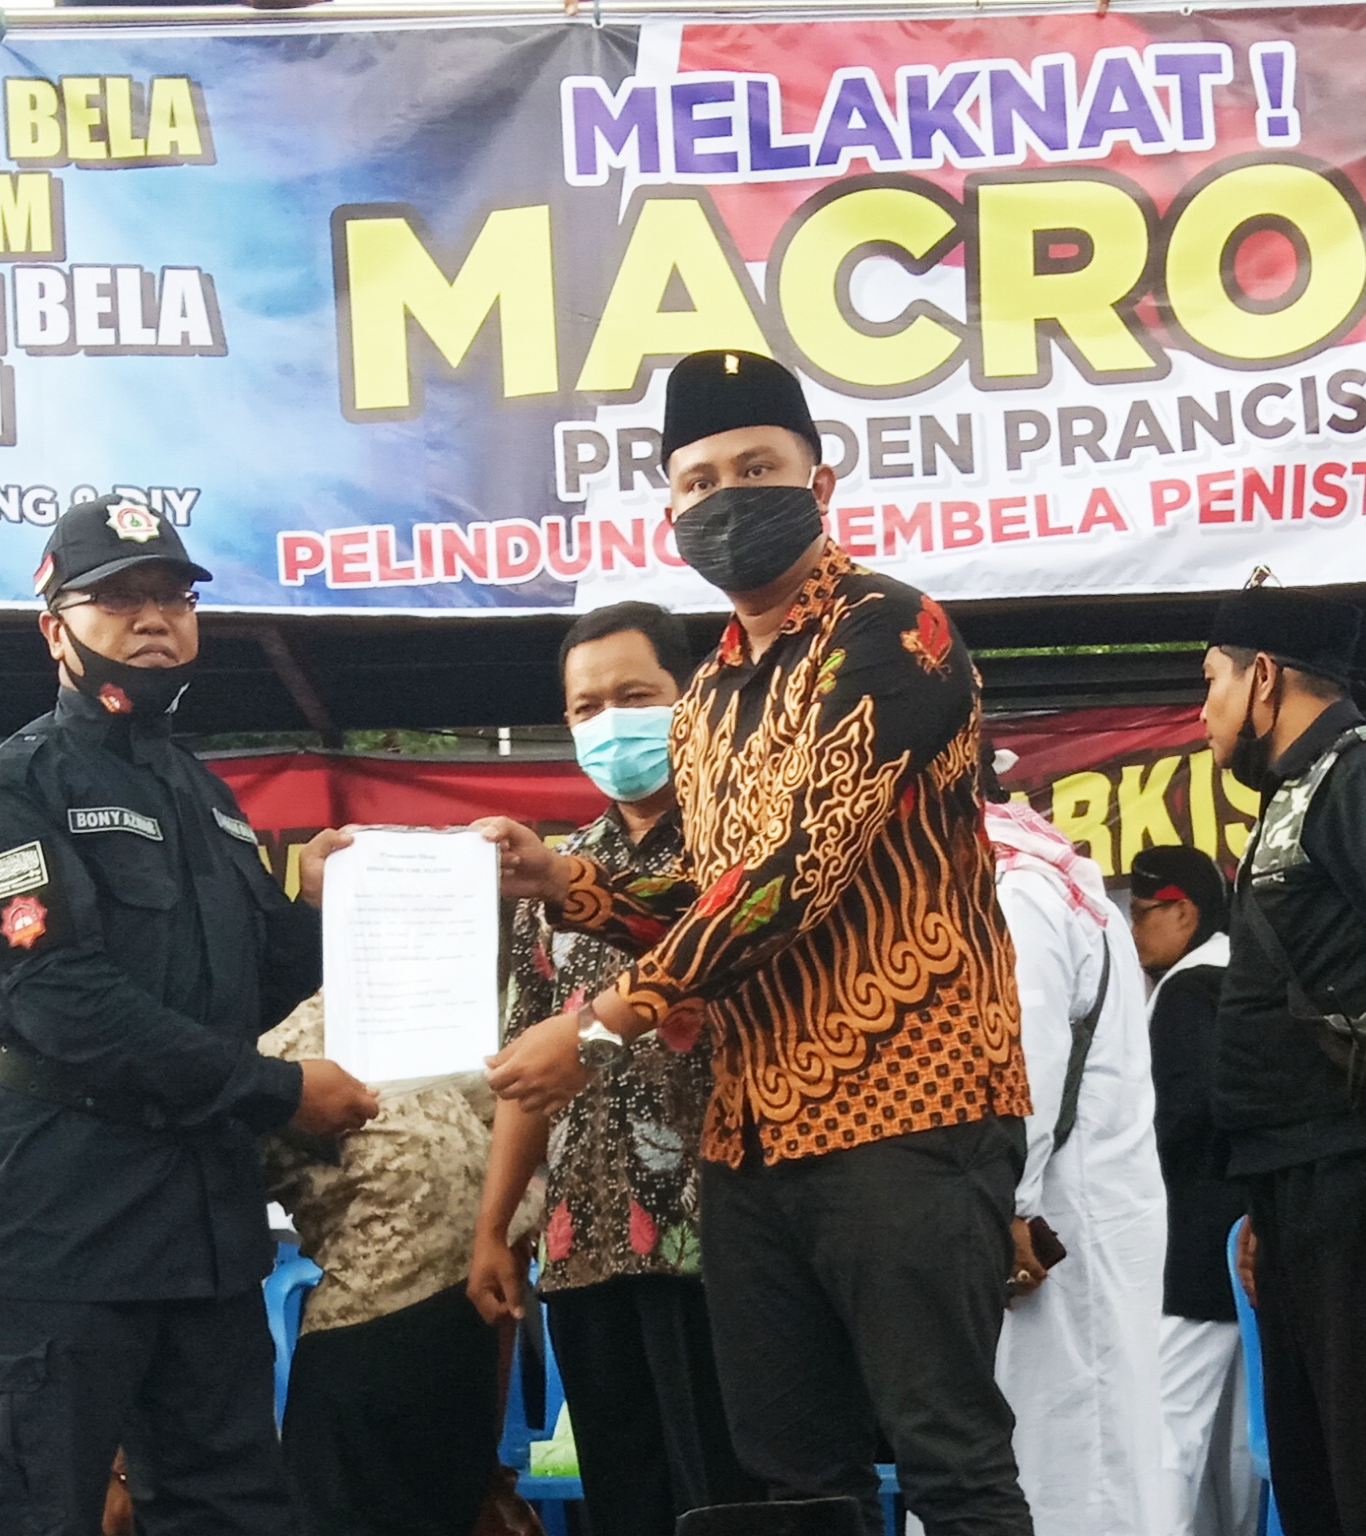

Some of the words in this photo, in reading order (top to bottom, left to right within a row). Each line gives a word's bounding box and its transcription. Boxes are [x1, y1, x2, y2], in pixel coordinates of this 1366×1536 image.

[4, 76, 203, 160] BELA
[571, 53, 1225, 175] MELAKNAT
[1261, 53, 1289, 138] !
[14, 267, 214, 346] BELA
[563, 413, 973, 495] PRDEN
[822, 487, 1128, 557] EMBELA
[76, 810, 121, 828] BONY
